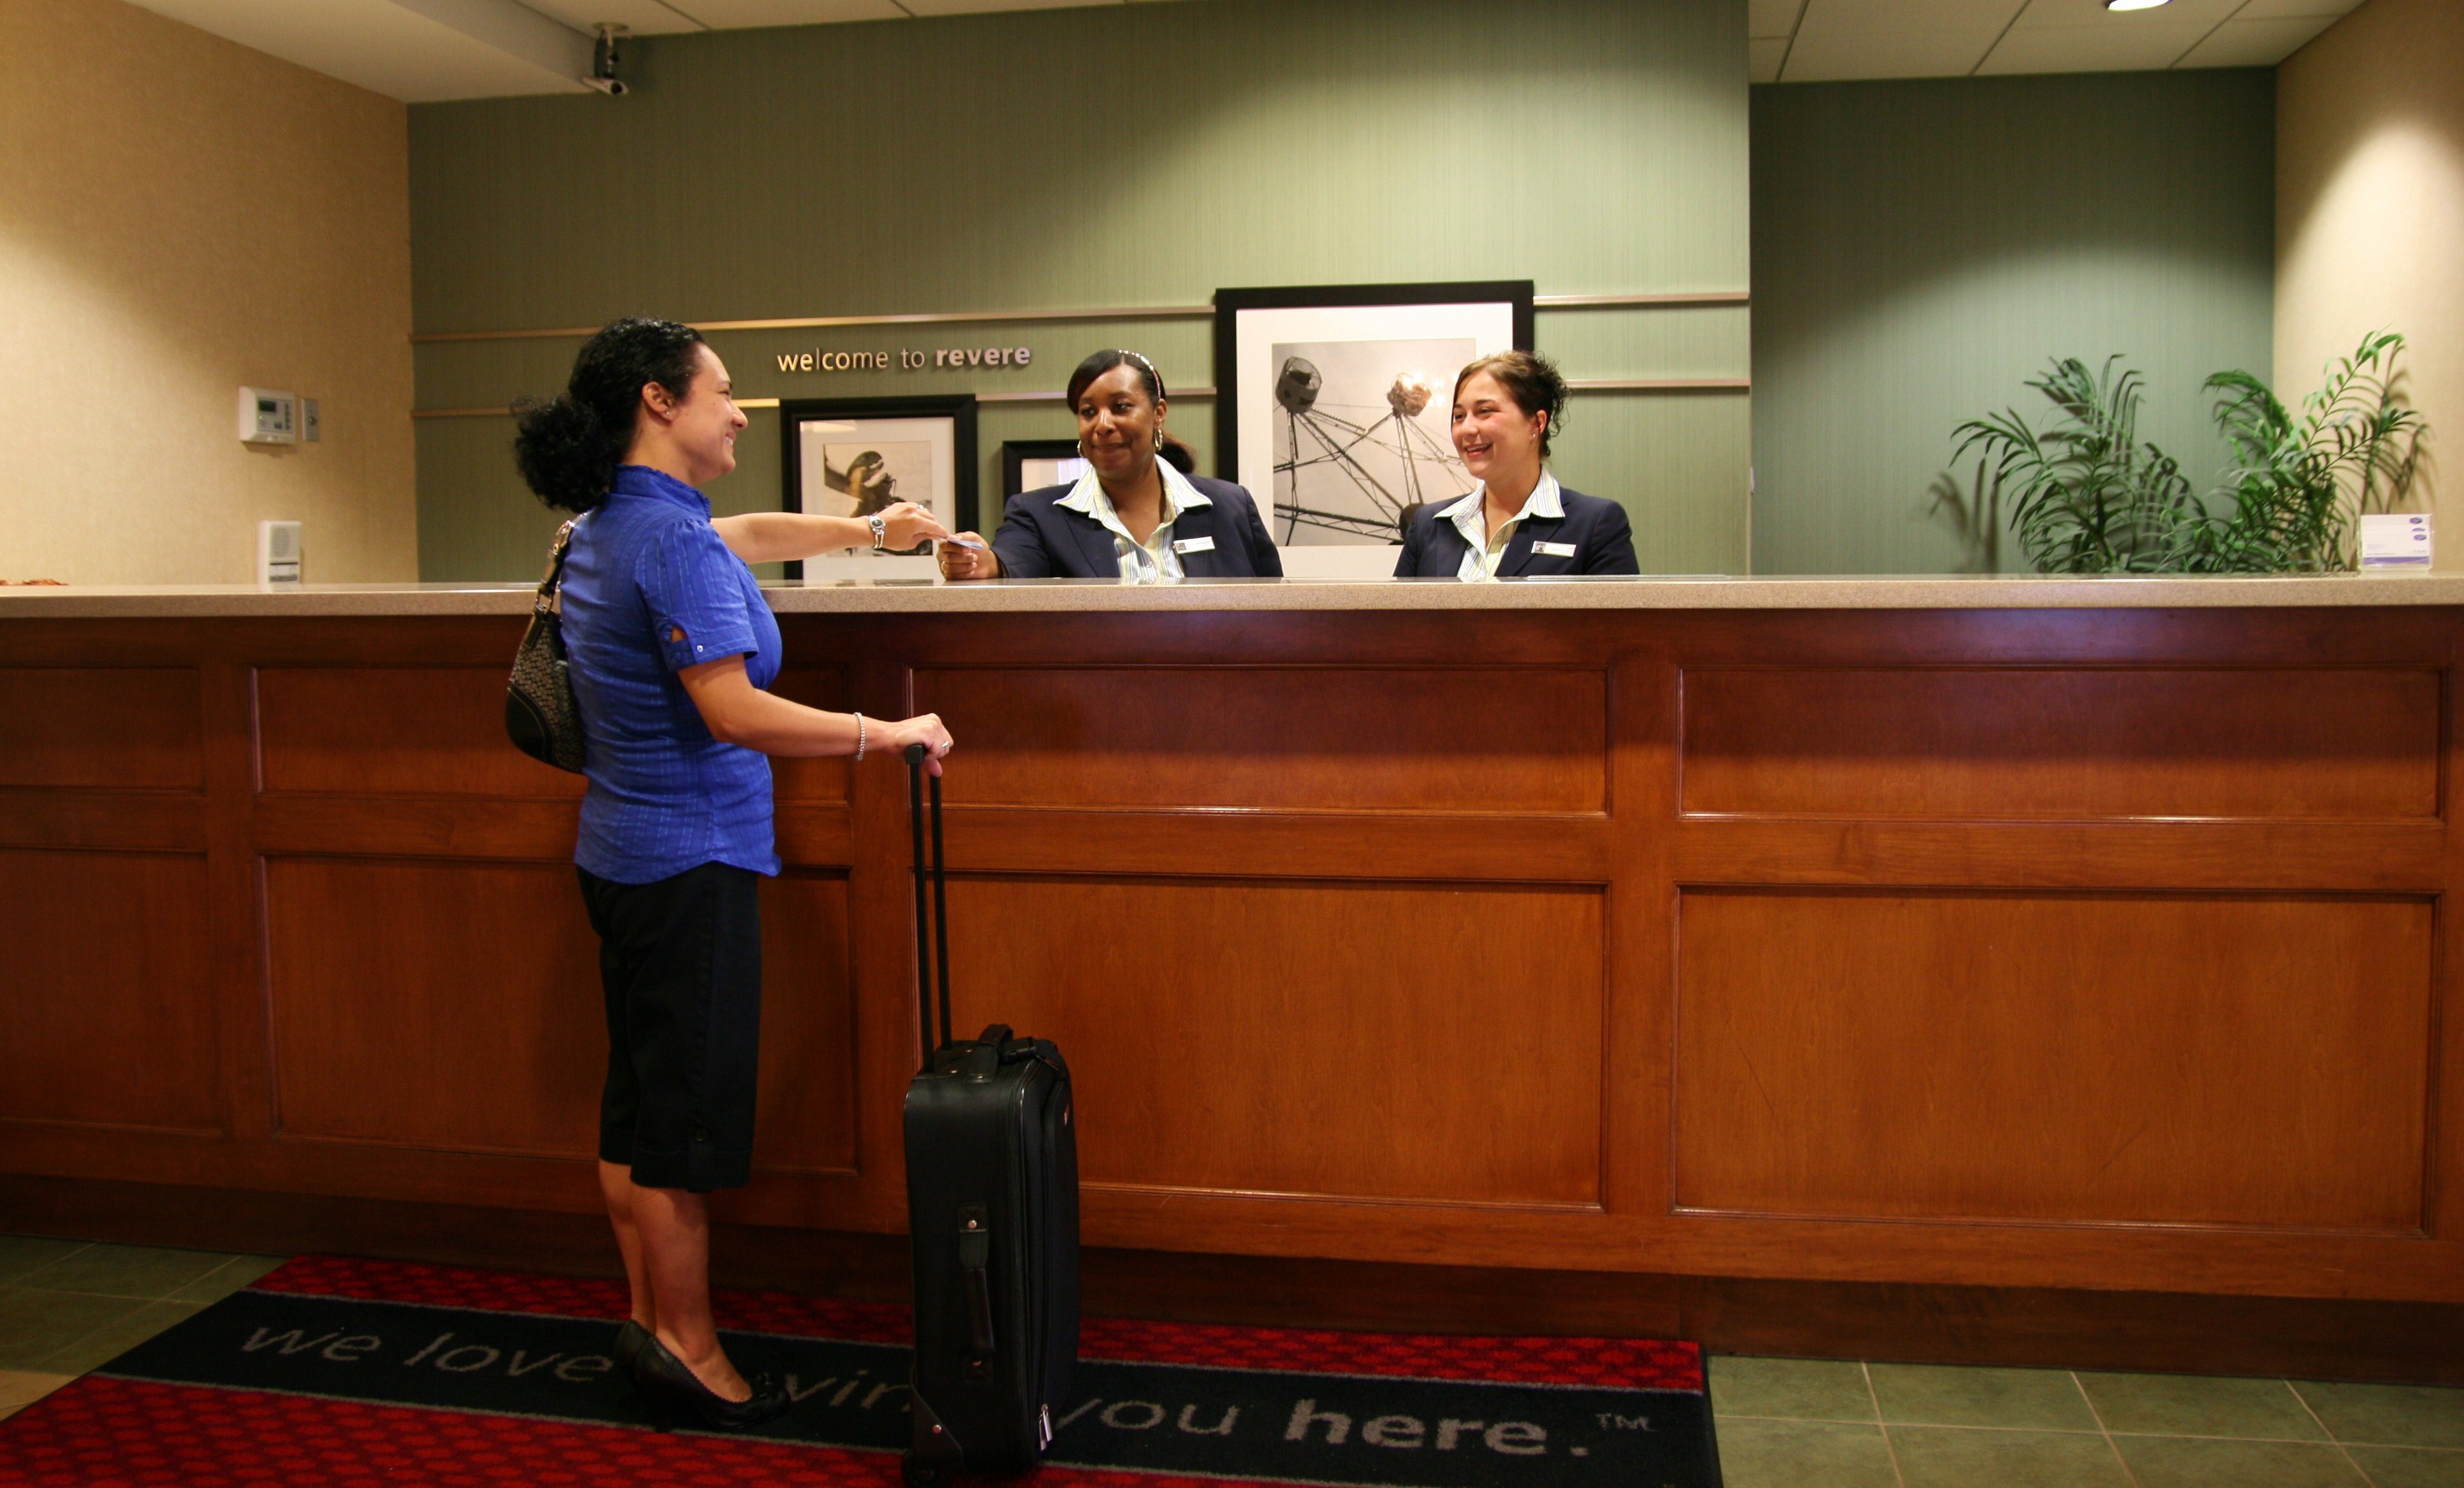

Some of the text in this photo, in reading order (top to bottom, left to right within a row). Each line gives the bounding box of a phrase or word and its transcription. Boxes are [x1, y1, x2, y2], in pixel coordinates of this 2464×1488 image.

[777, 346, 1031, 372] welcome to revere
[241, 1326, 382, 1361] we
[404, 1332, 613, 1383] love
[1284, 1398, 1589, 1457] here.
